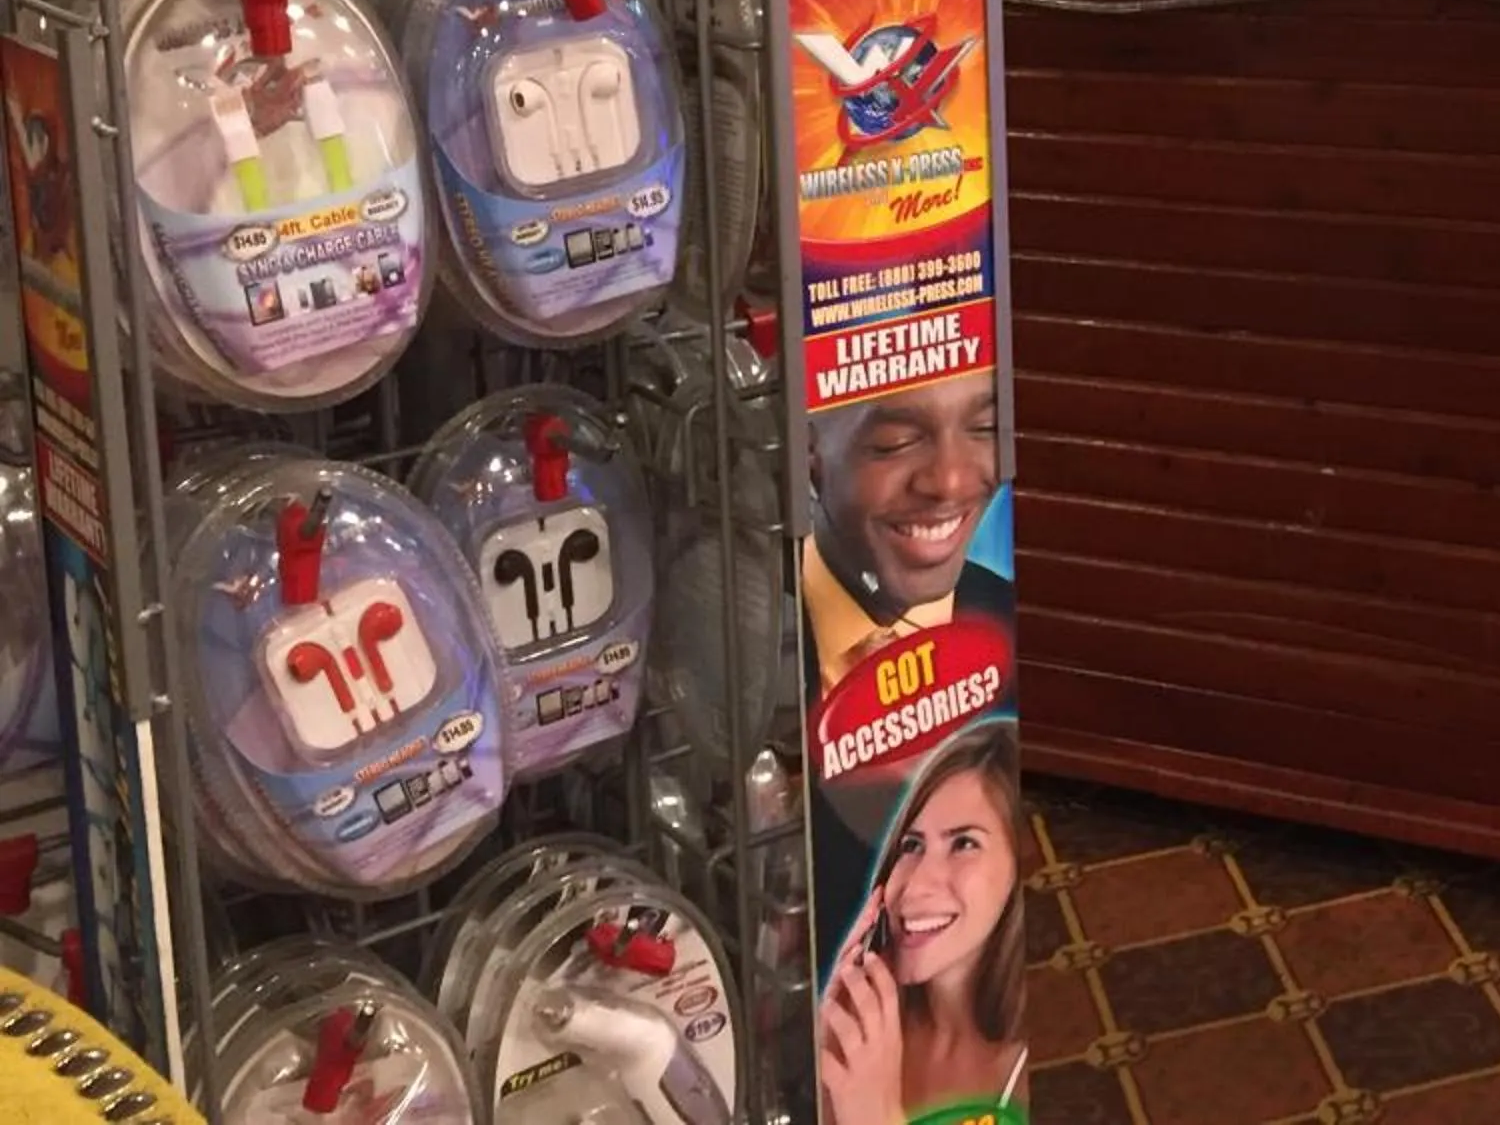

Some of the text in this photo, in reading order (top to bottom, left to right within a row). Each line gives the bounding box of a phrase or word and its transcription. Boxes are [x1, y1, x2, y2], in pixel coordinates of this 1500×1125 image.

[800, 159, 889, 201] WIRELESS
[890, 147, 963, 186] X-PRESS
[889, 174, 964, 224] More!
[280, 205, 358, 237] 4ft. Cable
[238, 257, 280, 283] SYNC
[296, 236, 353, 270] CHARGE
[357, 225, 400, 251] CABLE
[808, 279, 840, 303] TOLL
[843, 272, 877, 296] FREE:
[836, 313, 962, 366] LIFETIME
[816, 337, 981, 400] WARRANTY
[874, 641, 937, 708] GOT
[823, 664, 1001, 780] ACCESSORIES?
